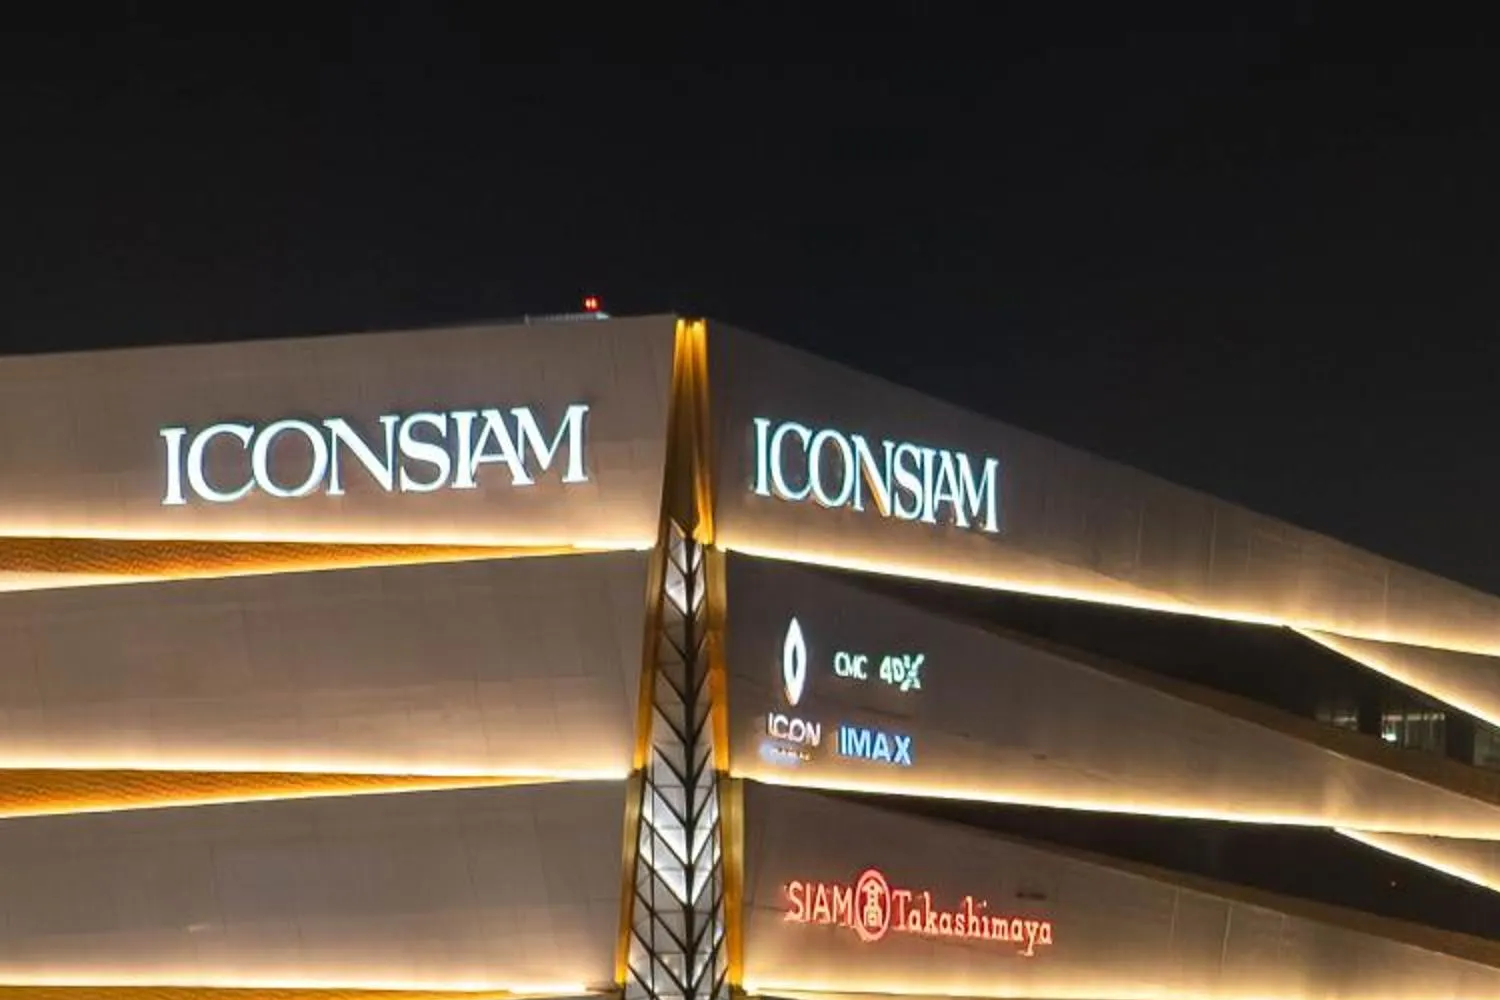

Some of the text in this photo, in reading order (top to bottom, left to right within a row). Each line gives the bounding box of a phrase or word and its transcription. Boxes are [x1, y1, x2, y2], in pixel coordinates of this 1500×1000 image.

[159, 404, 590, 505] ICONSIAM
[753, 416, 1001, 534] ICONSIAM
[878, 652, 925, 692] 4DX
[767, 711, 822, 747] ICON
[840, 725, 912, 766] IMAX
[784, 880, 1053, 956] SIAM Takashimaya
